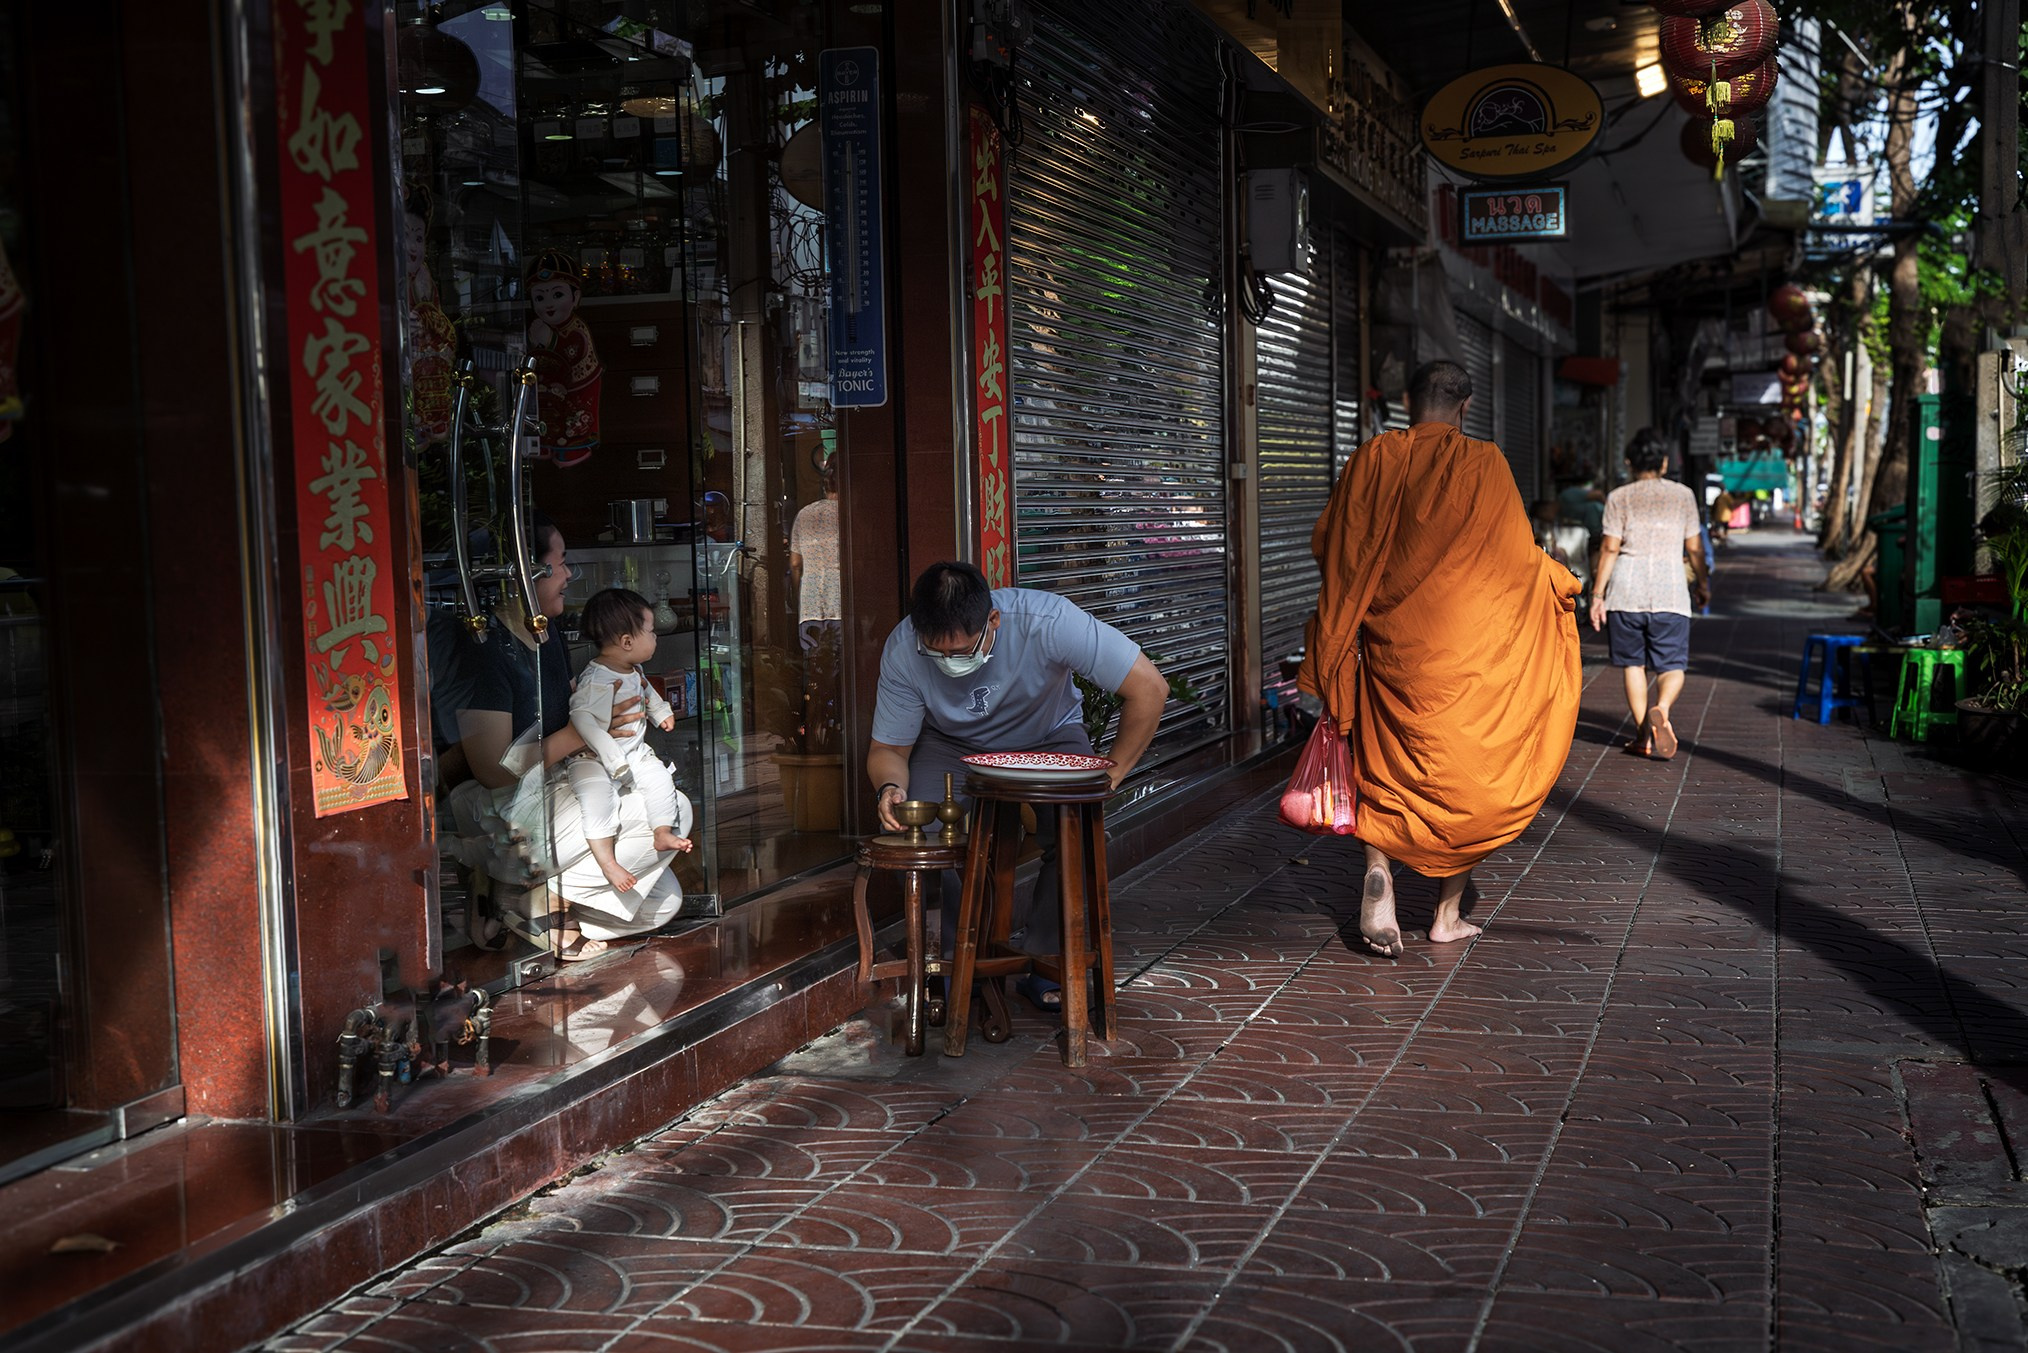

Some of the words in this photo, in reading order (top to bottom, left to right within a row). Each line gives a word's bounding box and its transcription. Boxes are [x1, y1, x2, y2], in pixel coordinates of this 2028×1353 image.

[828, 90, 868, 104] ASPIRIN
[1459, 147, 1502, 160] Sarpuri
[1504, 144, 1530, 156] Thai
[1533, 143, 1557, 155] Spa
[1487, 195, 1542, 216] นวด
[1471, 212, 1558, 234] MASSAGE
[838, 368, 873, 379] Bayer's
[837, 379, 874, 392] TONIC
